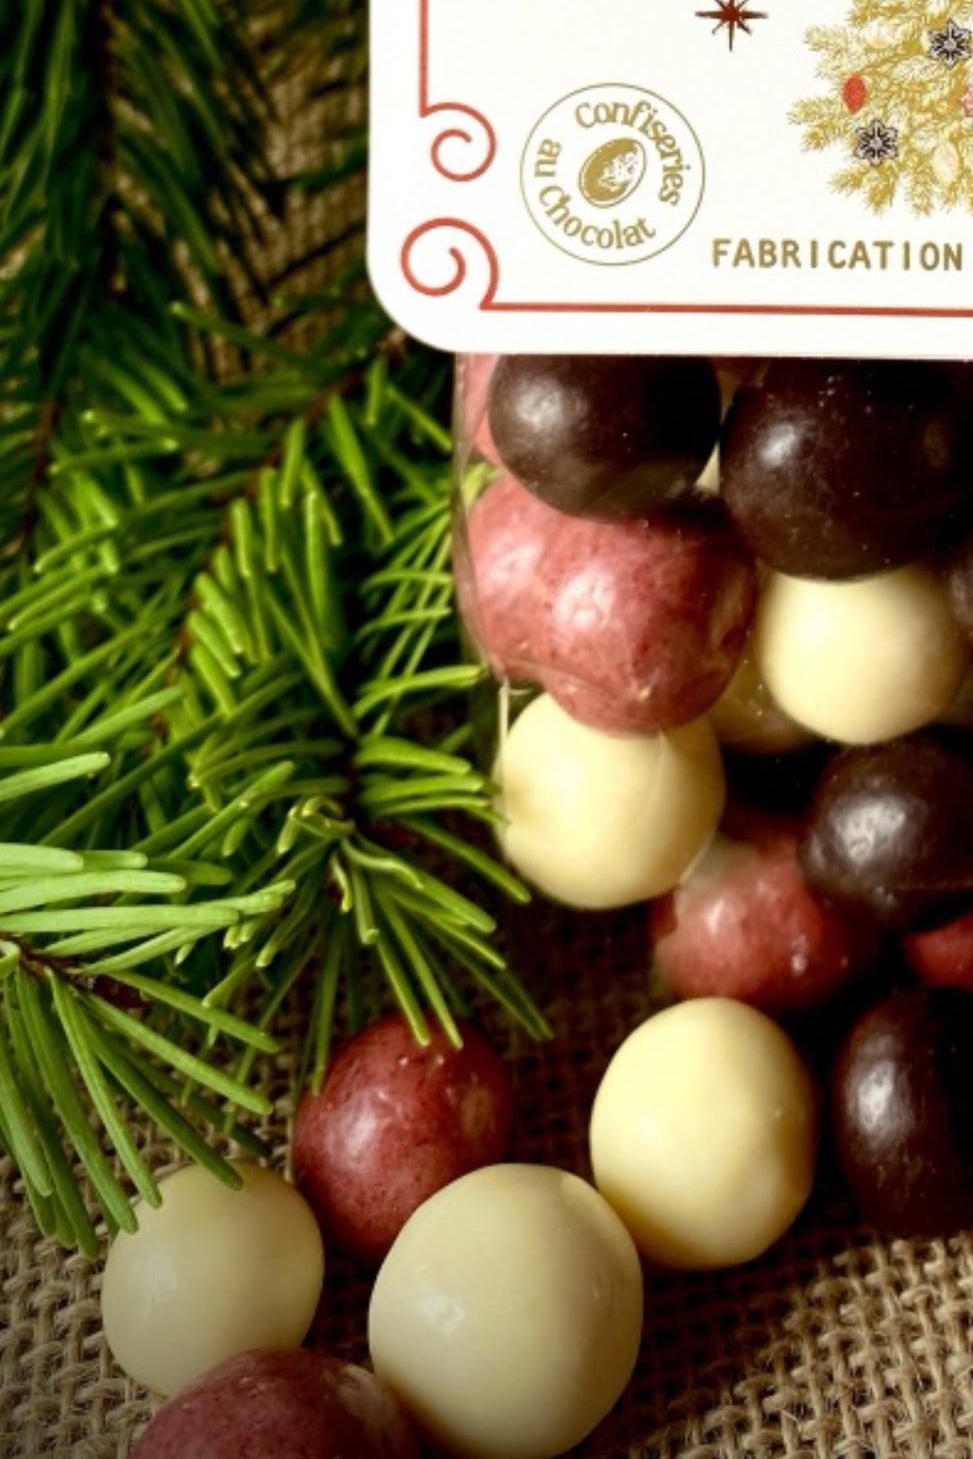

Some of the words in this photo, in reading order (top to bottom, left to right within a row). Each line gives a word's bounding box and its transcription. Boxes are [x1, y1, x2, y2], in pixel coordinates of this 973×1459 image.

[534, 138, 563, 178] au
[575, 100, 691, 206] Confiseries
[538, 185, 656, 249] Chocolat
[712, 238, 963, 271] FABRICATION
